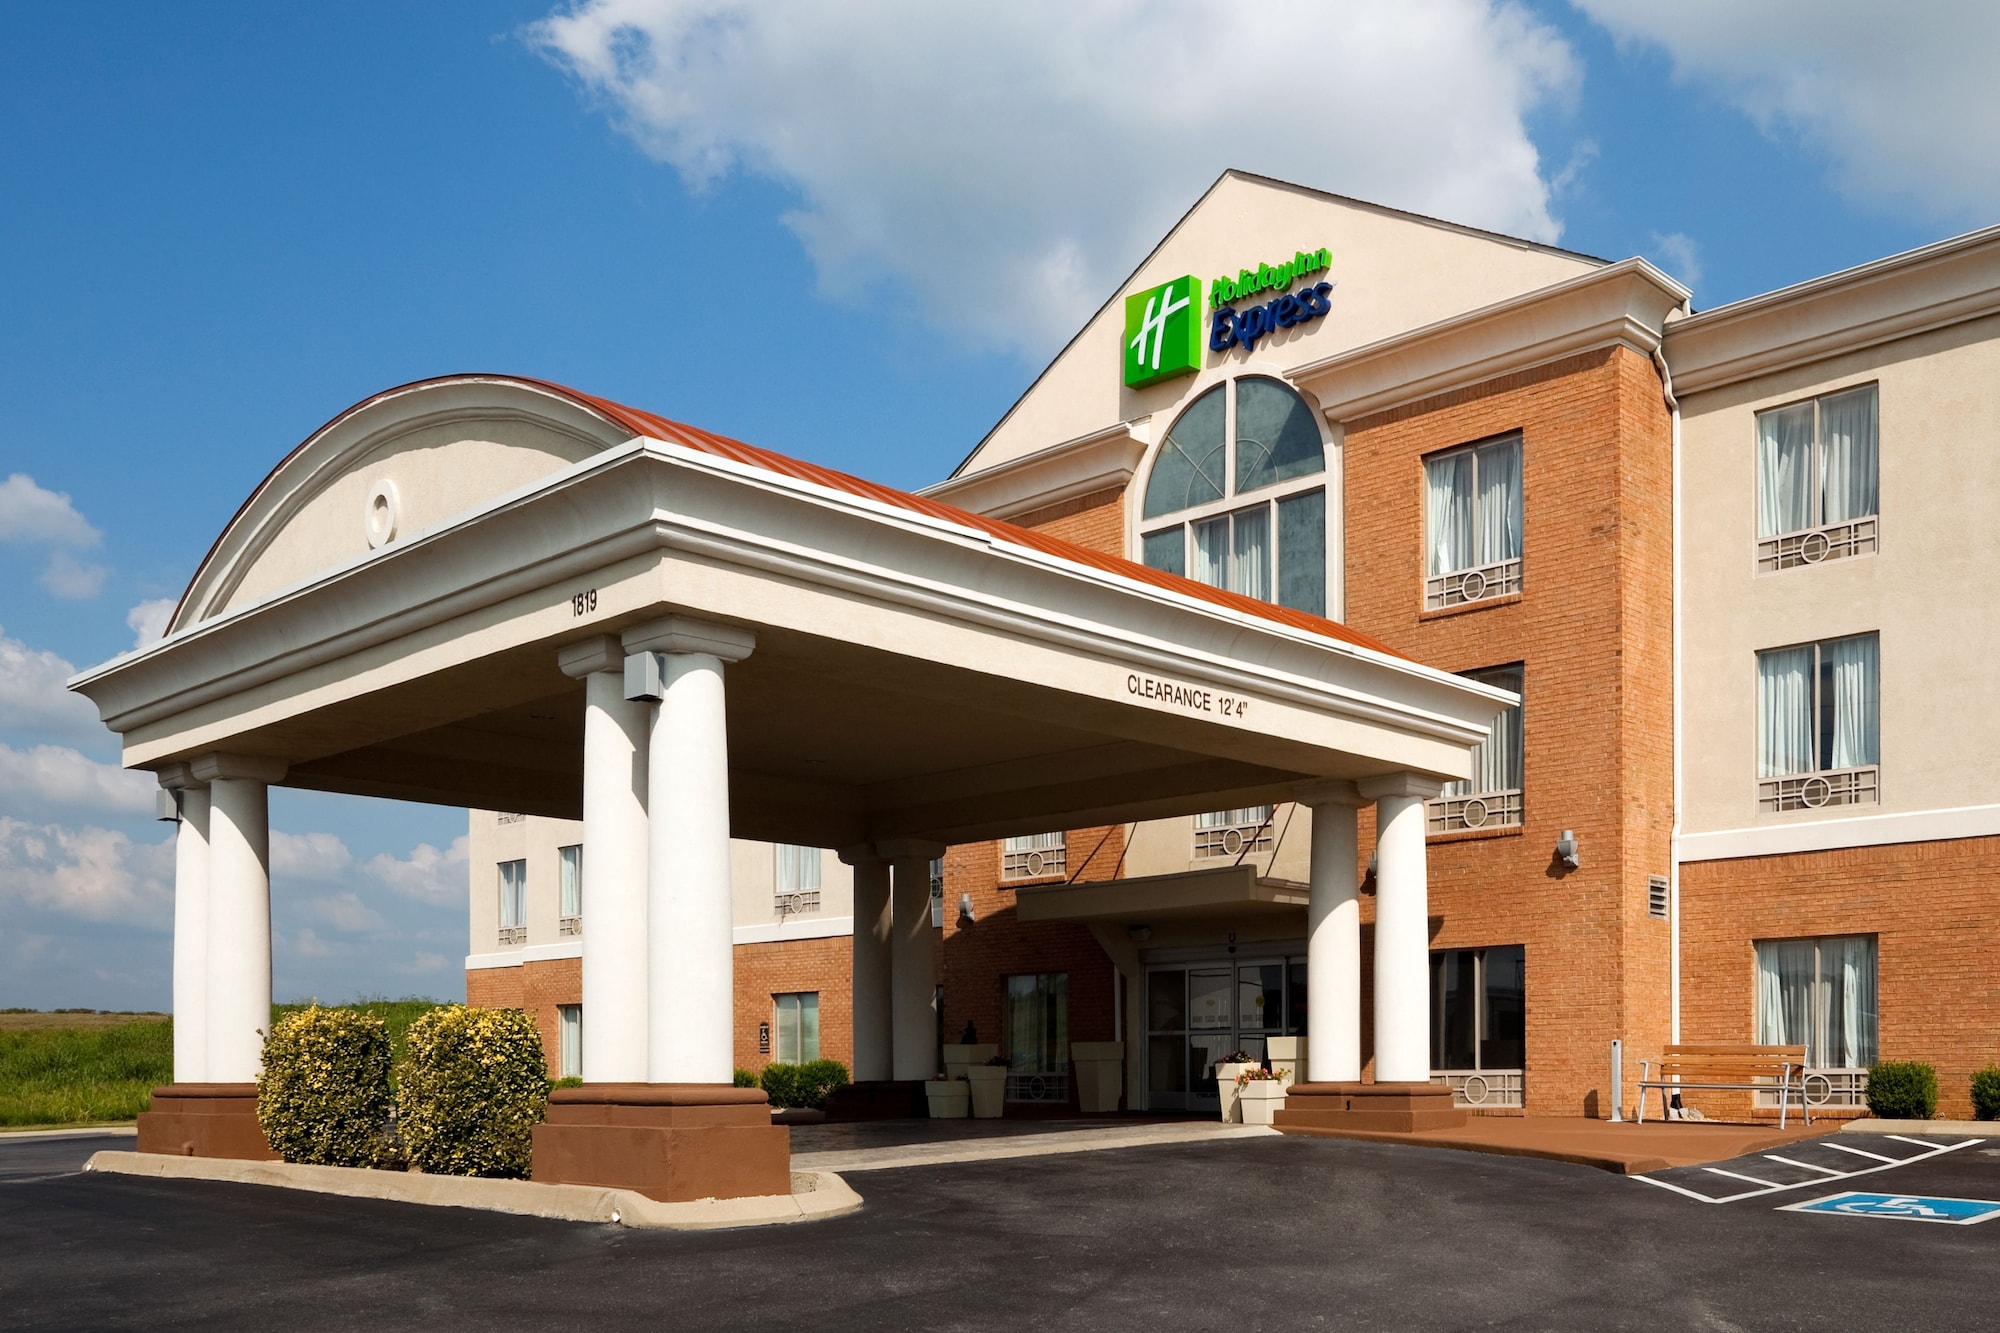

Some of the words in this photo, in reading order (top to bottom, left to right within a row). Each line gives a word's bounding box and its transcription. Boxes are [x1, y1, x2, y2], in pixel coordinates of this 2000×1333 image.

[1208, 260, 1293, 310] Holiday
[1291, 248, 1332, 277] Inn
[1209, 282, 1333, 352] Express
[572, 588, 597, 617] 1819
[1127, 674, 1211, 712] CLEARANCE
